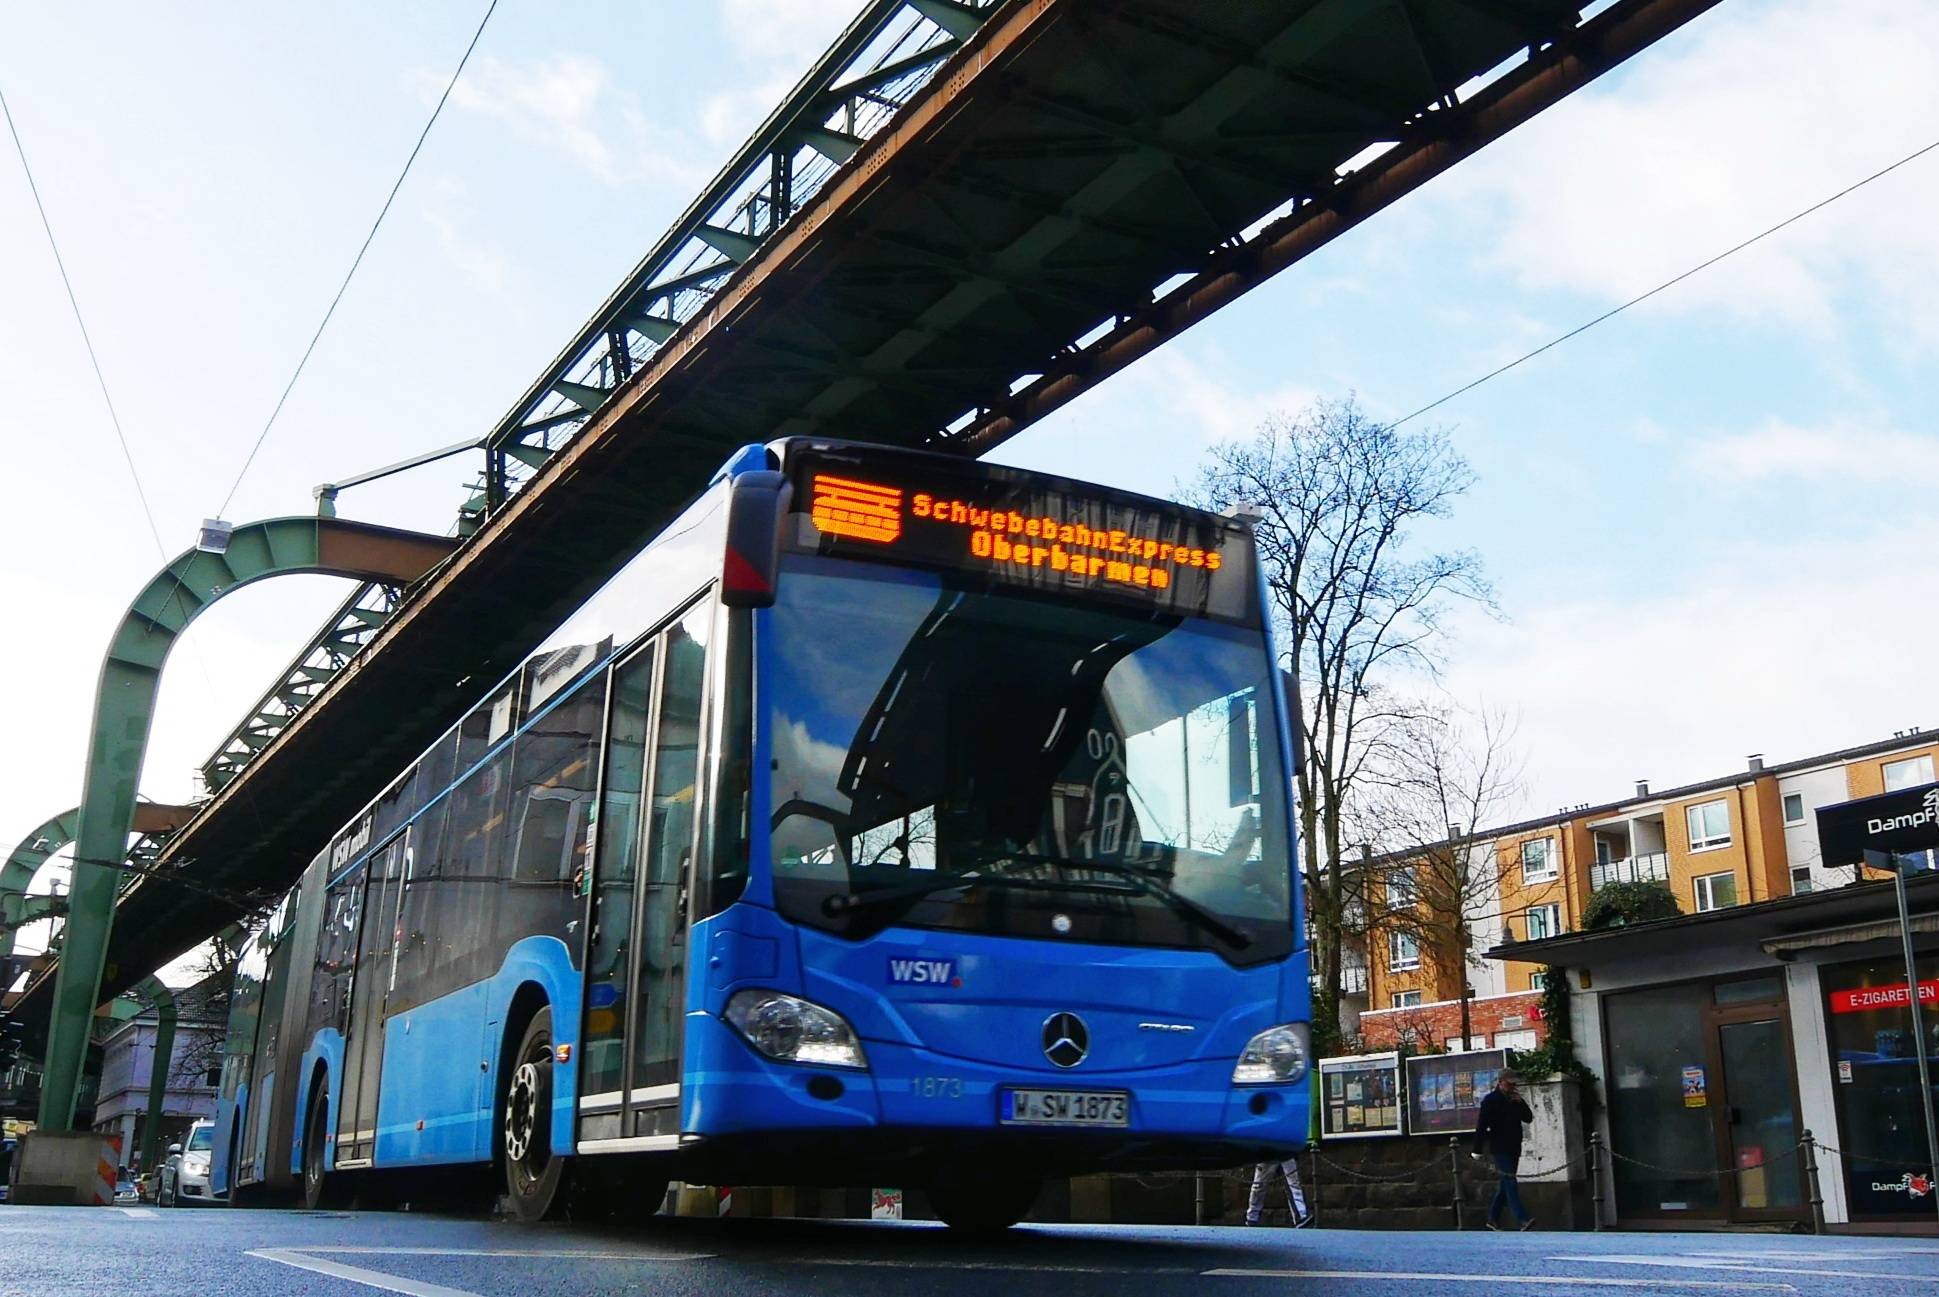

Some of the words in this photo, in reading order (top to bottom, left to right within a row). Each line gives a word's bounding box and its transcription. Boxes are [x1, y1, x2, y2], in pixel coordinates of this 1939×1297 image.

[912, 494, 1222, 570] SchwebebahnExpress
[970, 530, 1171, 589] Oberbarmen
[1849, 985, 1935, 1007] E-ZIGARETEN
[911, 1077, 962, 1098] 1873
